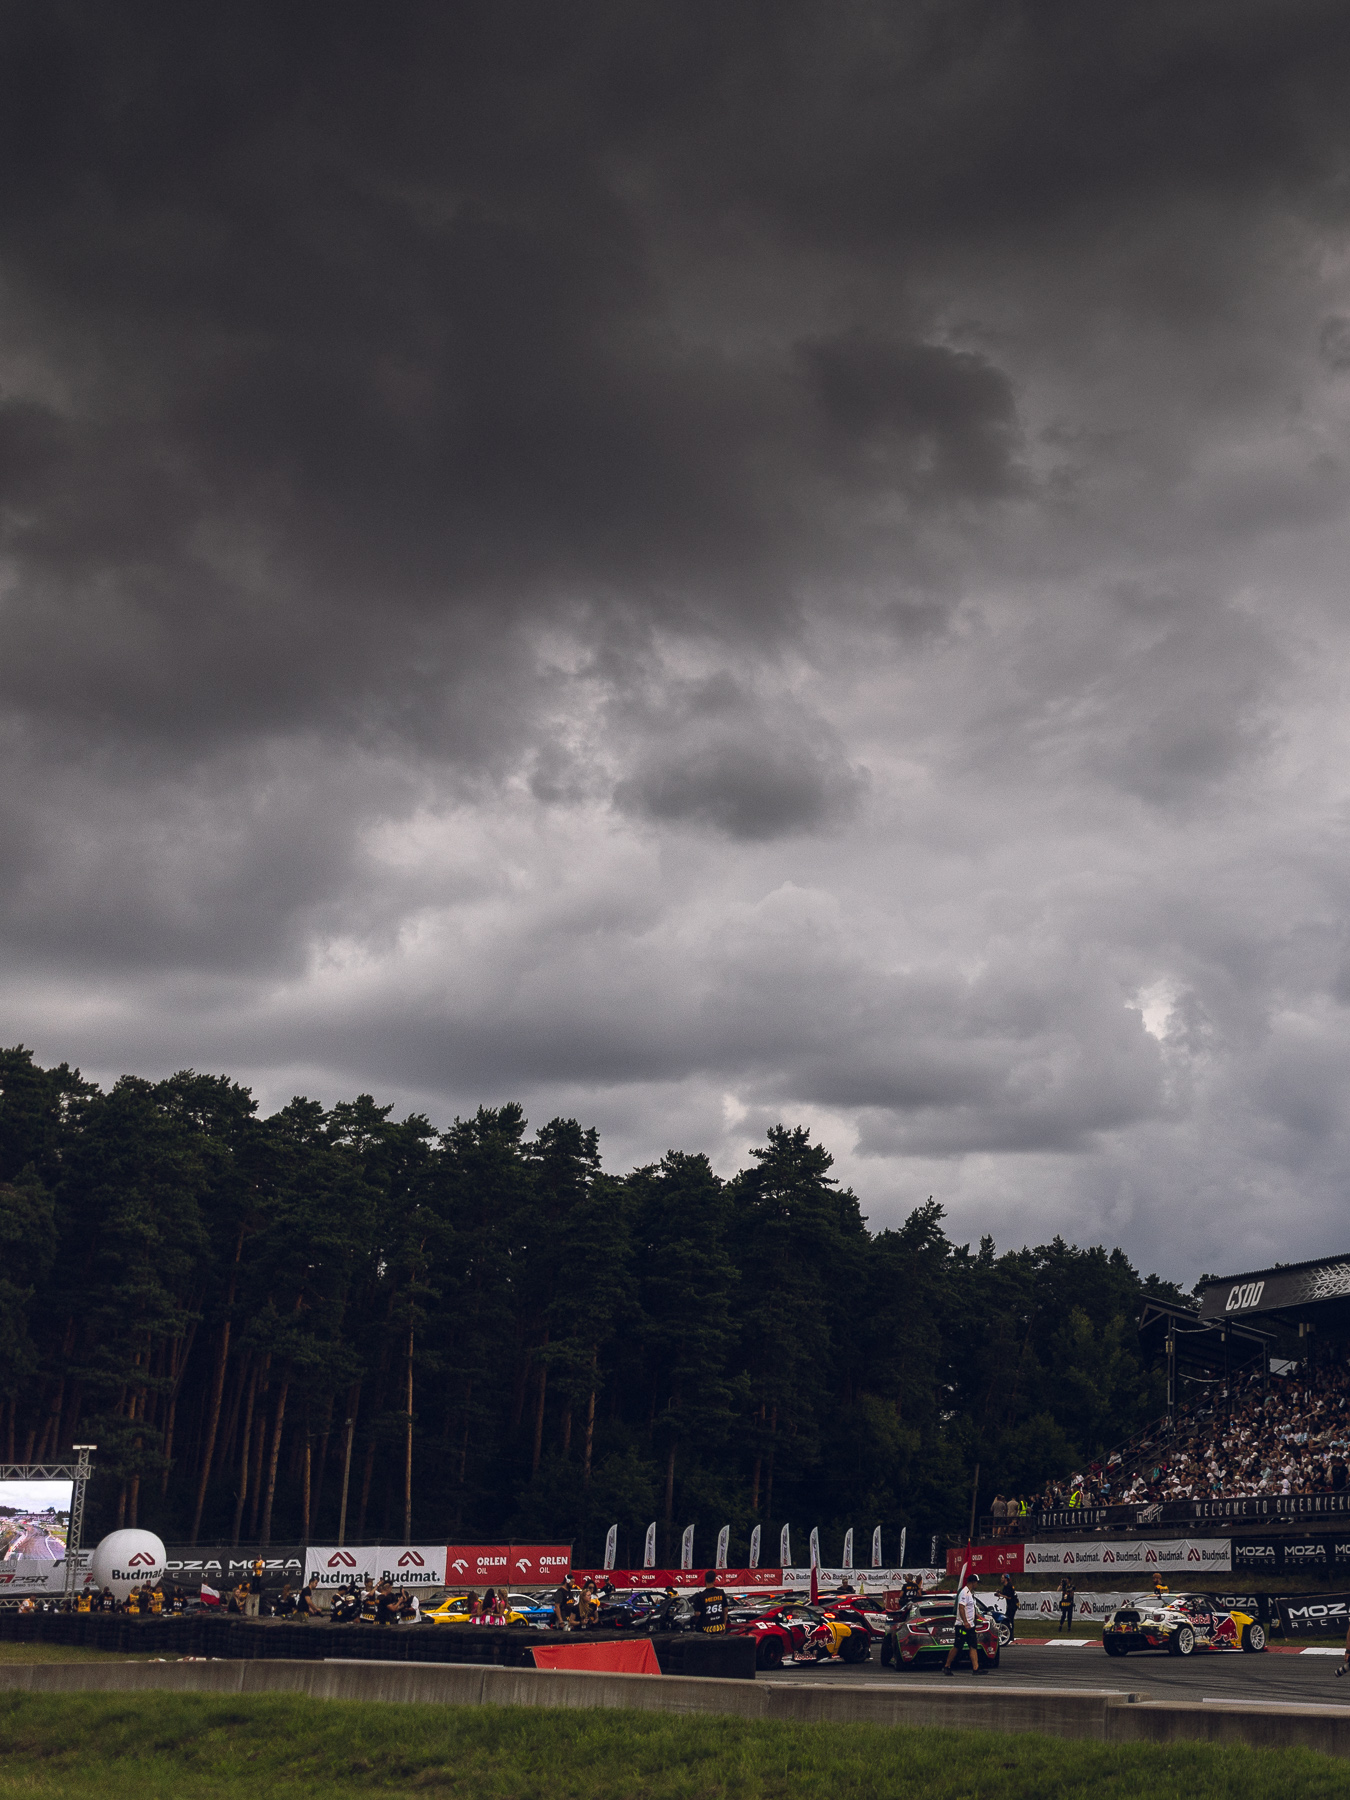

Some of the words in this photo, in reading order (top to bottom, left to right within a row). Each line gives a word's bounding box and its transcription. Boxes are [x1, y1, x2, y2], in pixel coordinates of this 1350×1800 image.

[1225, 1281, 1265, 1311] CSDD
[1195, 1501, 1247, 1517] WELCOME
[1255, 1500, 1268, 1514] TO
[1277, 1496, 1350, 1513] BIKERNIEKI
[1202, 1550, 1230, 1560] Budmat.
[1235, 1546, 1275, 1556] MOZA
[1284, 1545, 1326, 1555] MOZA
[540, 1556, 568, 1565] ORLEN
[1038, 1553, 1060, 1562] Budmat.
[1076, 1552, 1100, 1562] Budmat.
[1116, 1551, 1142, 1561] Budmat.
[1159, 1551, 1184, 1560] Budmat.
[165, 1560, 222, 1570] OZA
[477, 1557, 507, 1565] ORLEN
[112, 1568, 163, 1580] Budmat.
[311, 1571, 370, 1583] Budmat
[382, 1570, 440, 1582] Budmat.
[1018, 1602, 1038, 1610] udmat.
[1053, 1602, 1077, 1611] But.
[1291, 1617, 1350, 1628] RACI
